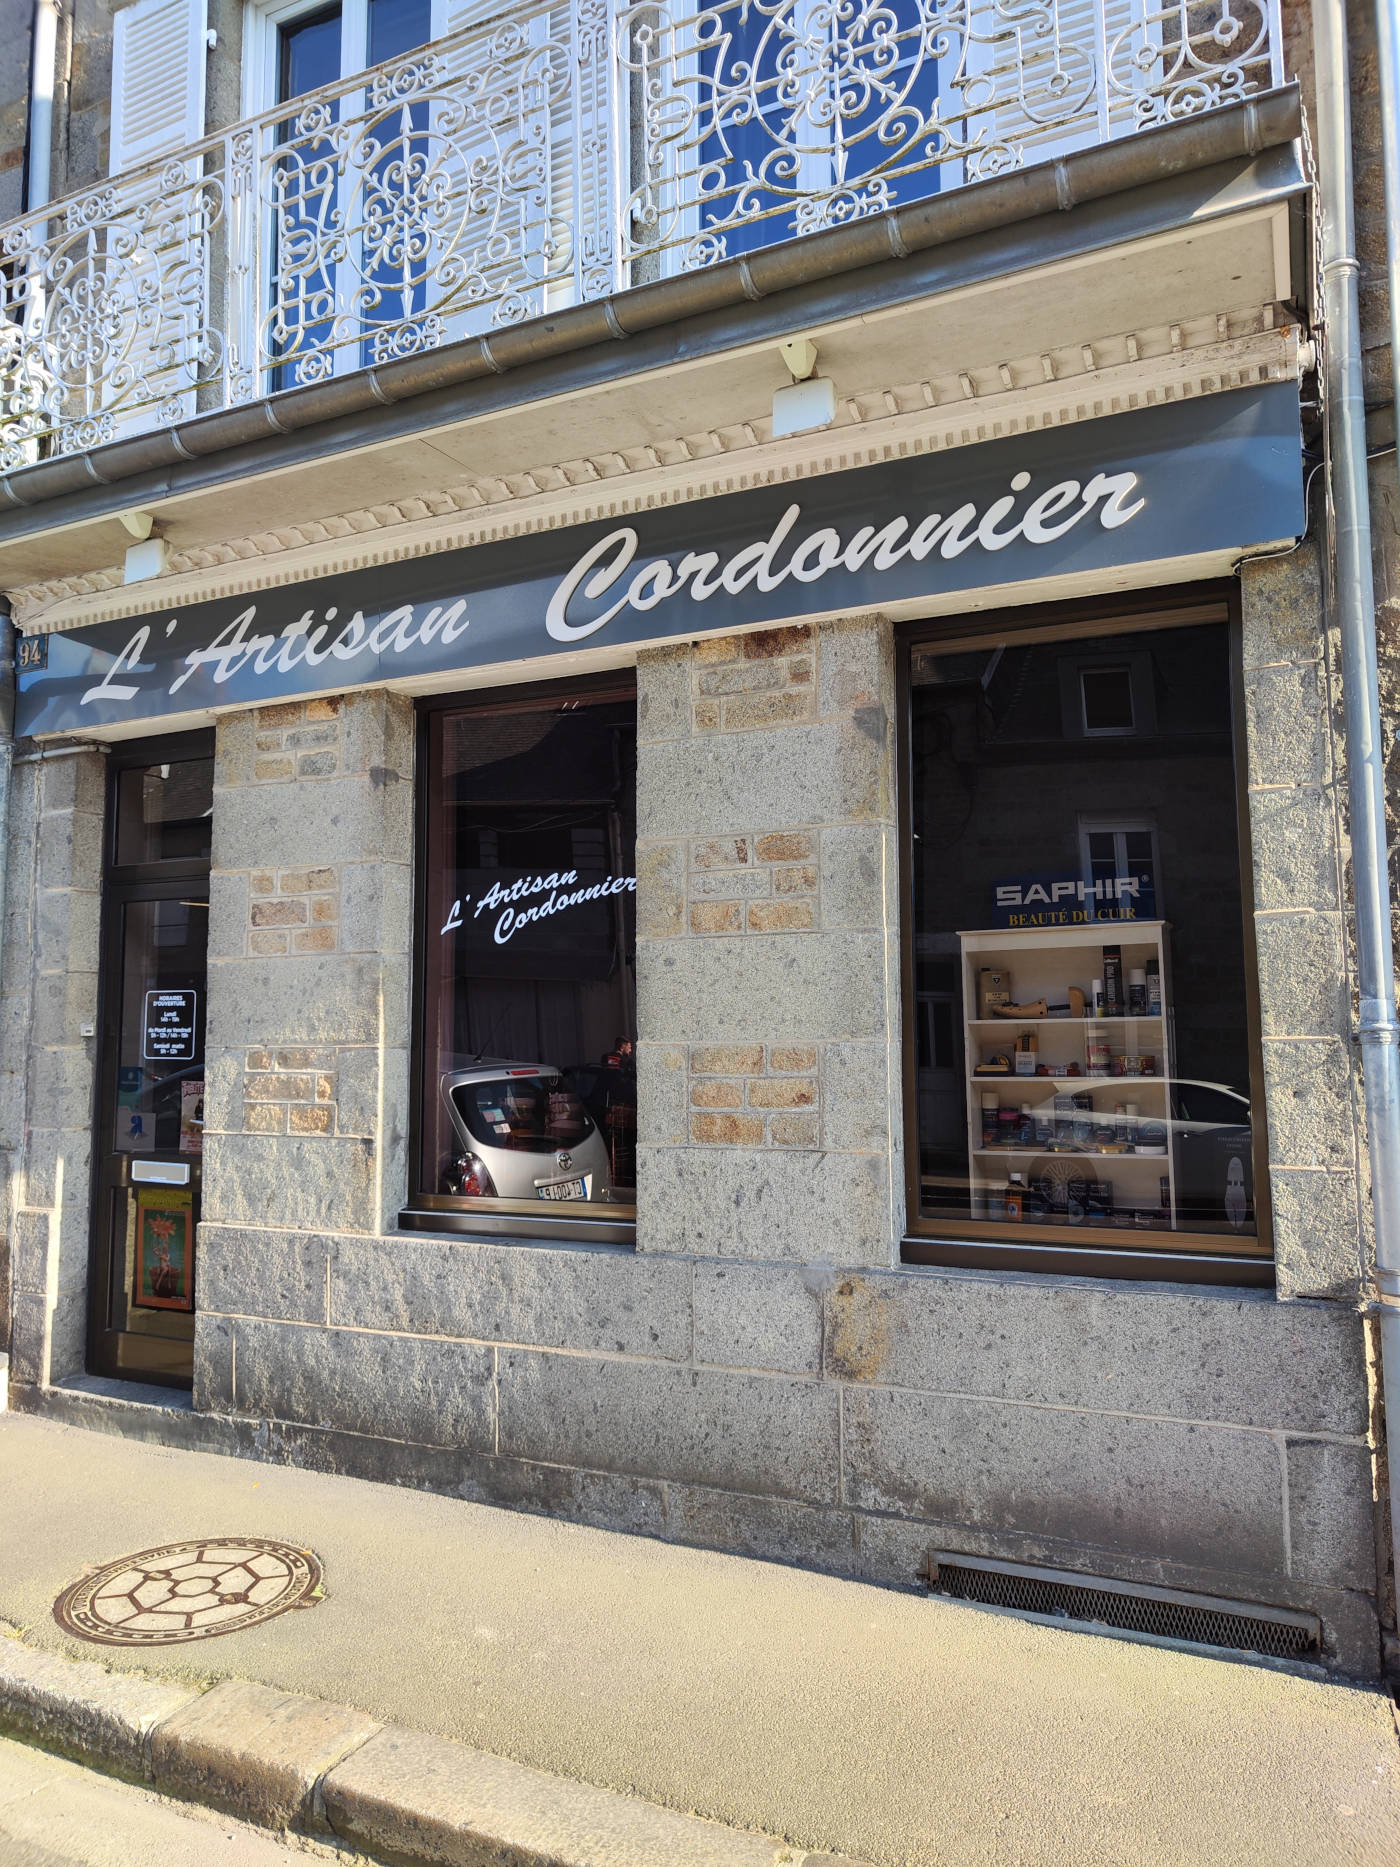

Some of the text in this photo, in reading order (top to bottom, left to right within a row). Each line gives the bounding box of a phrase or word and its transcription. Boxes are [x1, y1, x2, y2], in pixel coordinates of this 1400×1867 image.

[545, 471, 1145, 642] Cordonnier
[20, 640, 41, 666] 94
[996, 877, 1140, 906] SAPHIR
[493, 876, 637, 944] Cordonnier
[1008, 907, 1136, 926] BEAUTÉ DU CUIR
